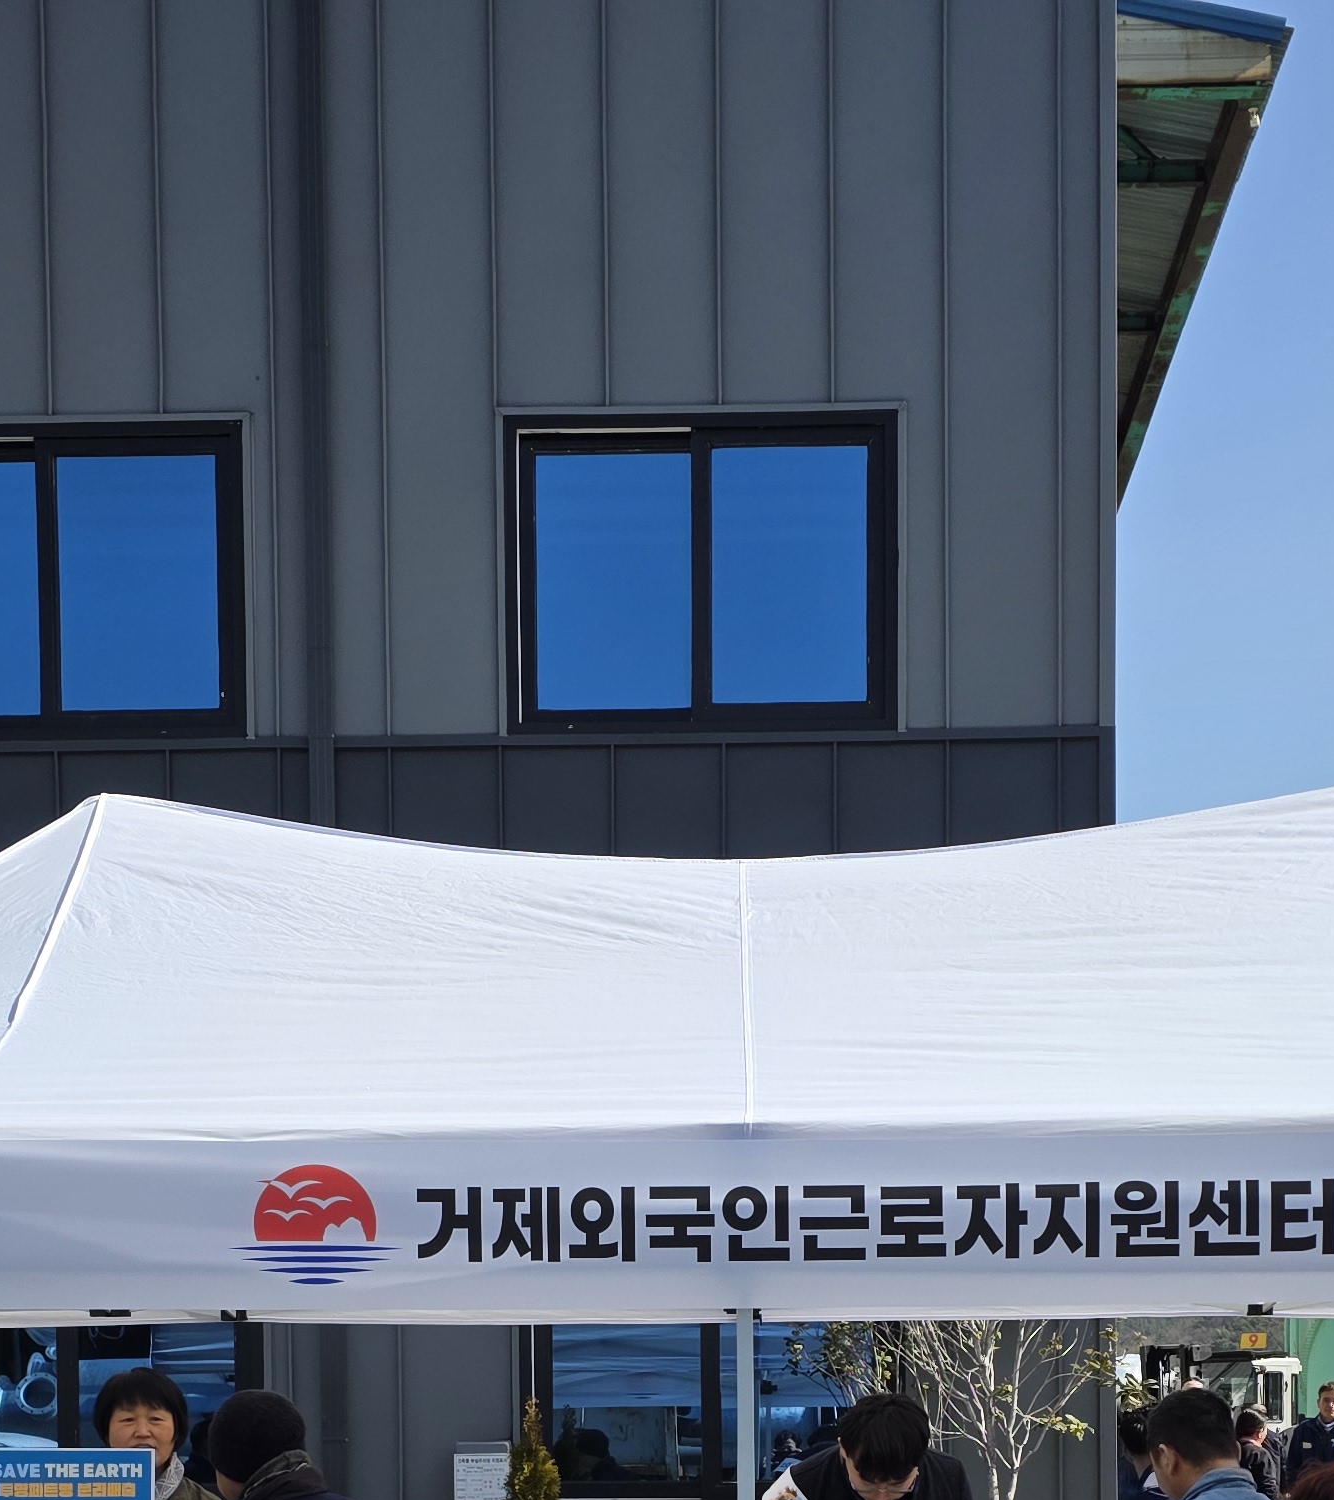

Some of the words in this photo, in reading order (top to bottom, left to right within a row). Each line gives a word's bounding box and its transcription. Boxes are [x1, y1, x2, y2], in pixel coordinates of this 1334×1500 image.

[1249, 1333, 1259, 1346] 9
[44, 1463, 80, 1478] THE
[83, 1463, 143, 1478] EARTH
